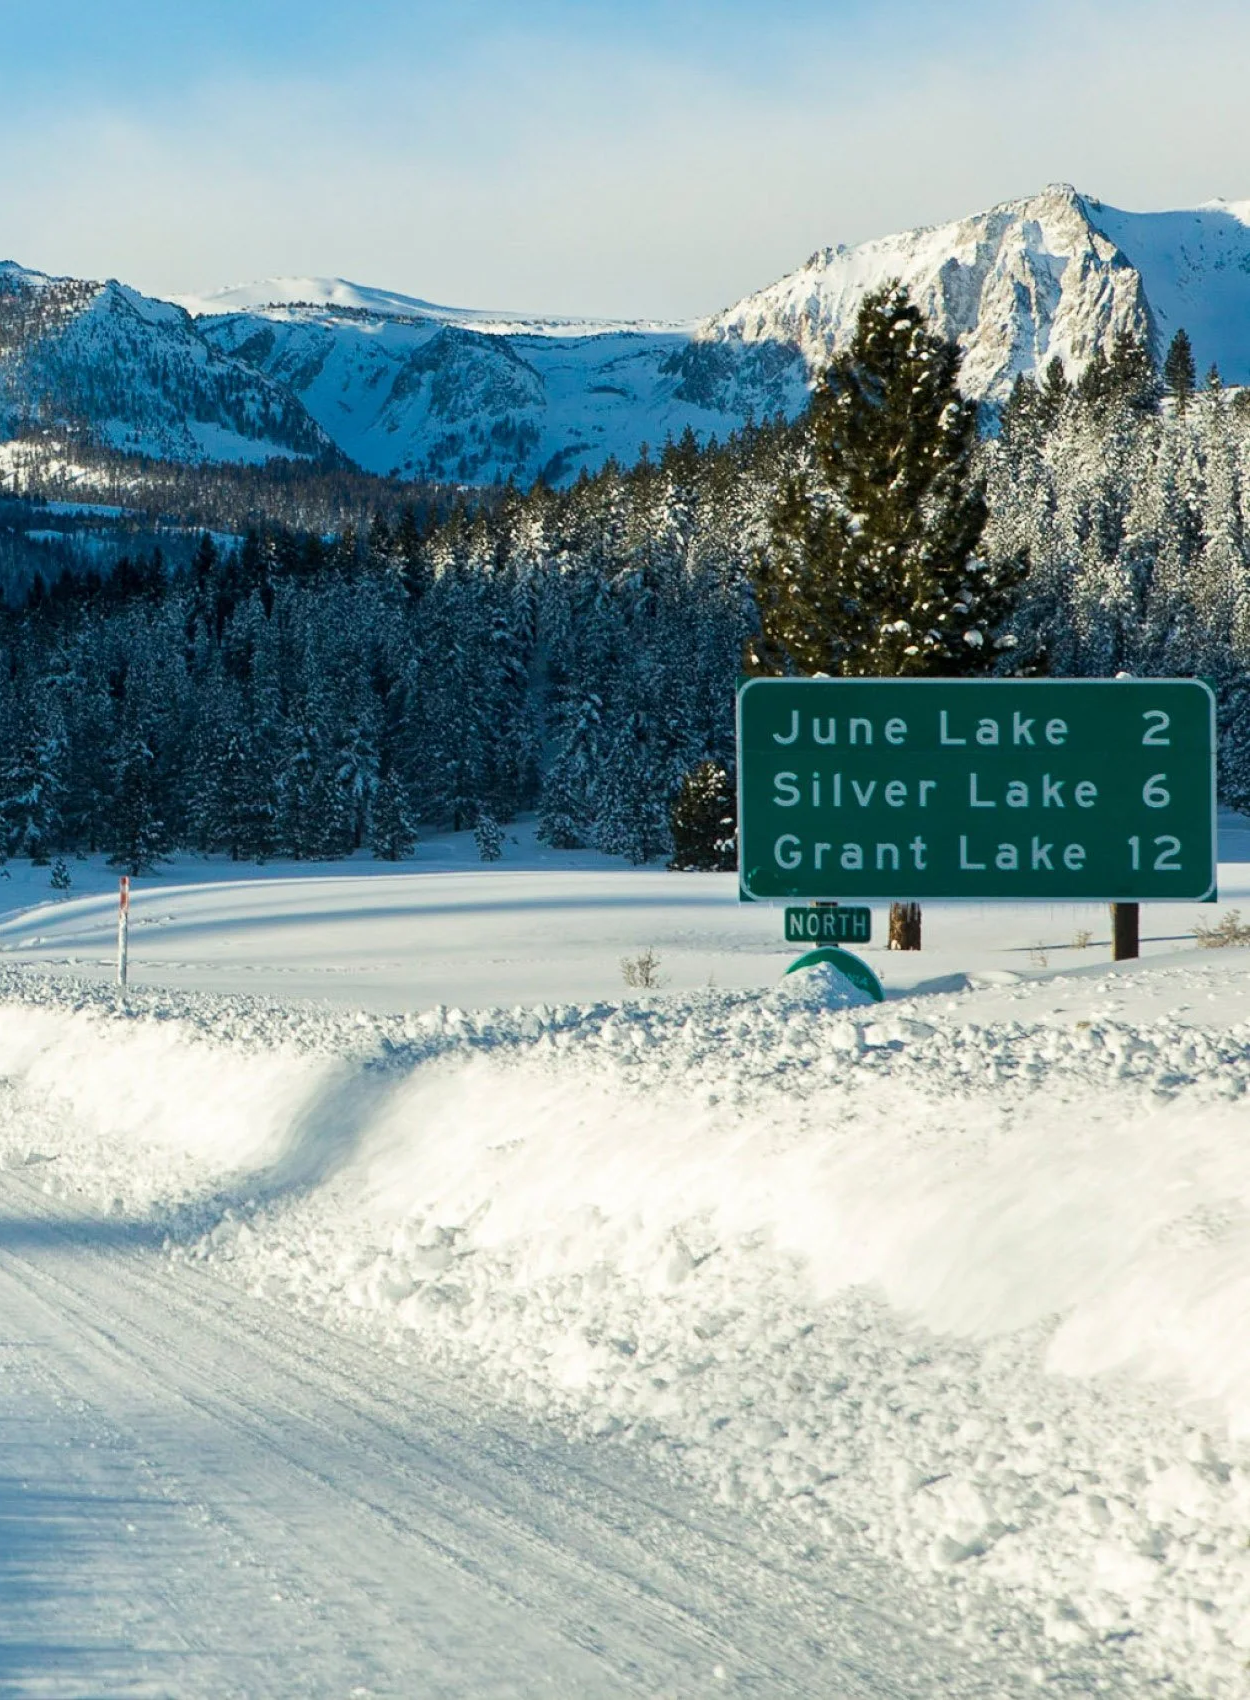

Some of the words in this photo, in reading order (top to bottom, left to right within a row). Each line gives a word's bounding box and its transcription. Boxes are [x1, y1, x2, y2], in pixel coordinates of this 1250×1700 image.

[773, 711, 906, 743] June
[941, 711, 1067, 744] Lake
[1143, 710, 1169, 744] 2
[774, 772, 935, 806] Silver
[971, 773, 1096, 807] Lake
[1143, 774, 1169, 807] 6
[775, 834, 925, 869] Grant
[960, 836, 1085, 869] Lake
[1129, 836, 1180, 870] 12
[790, 913, 866, 936] NORTH
